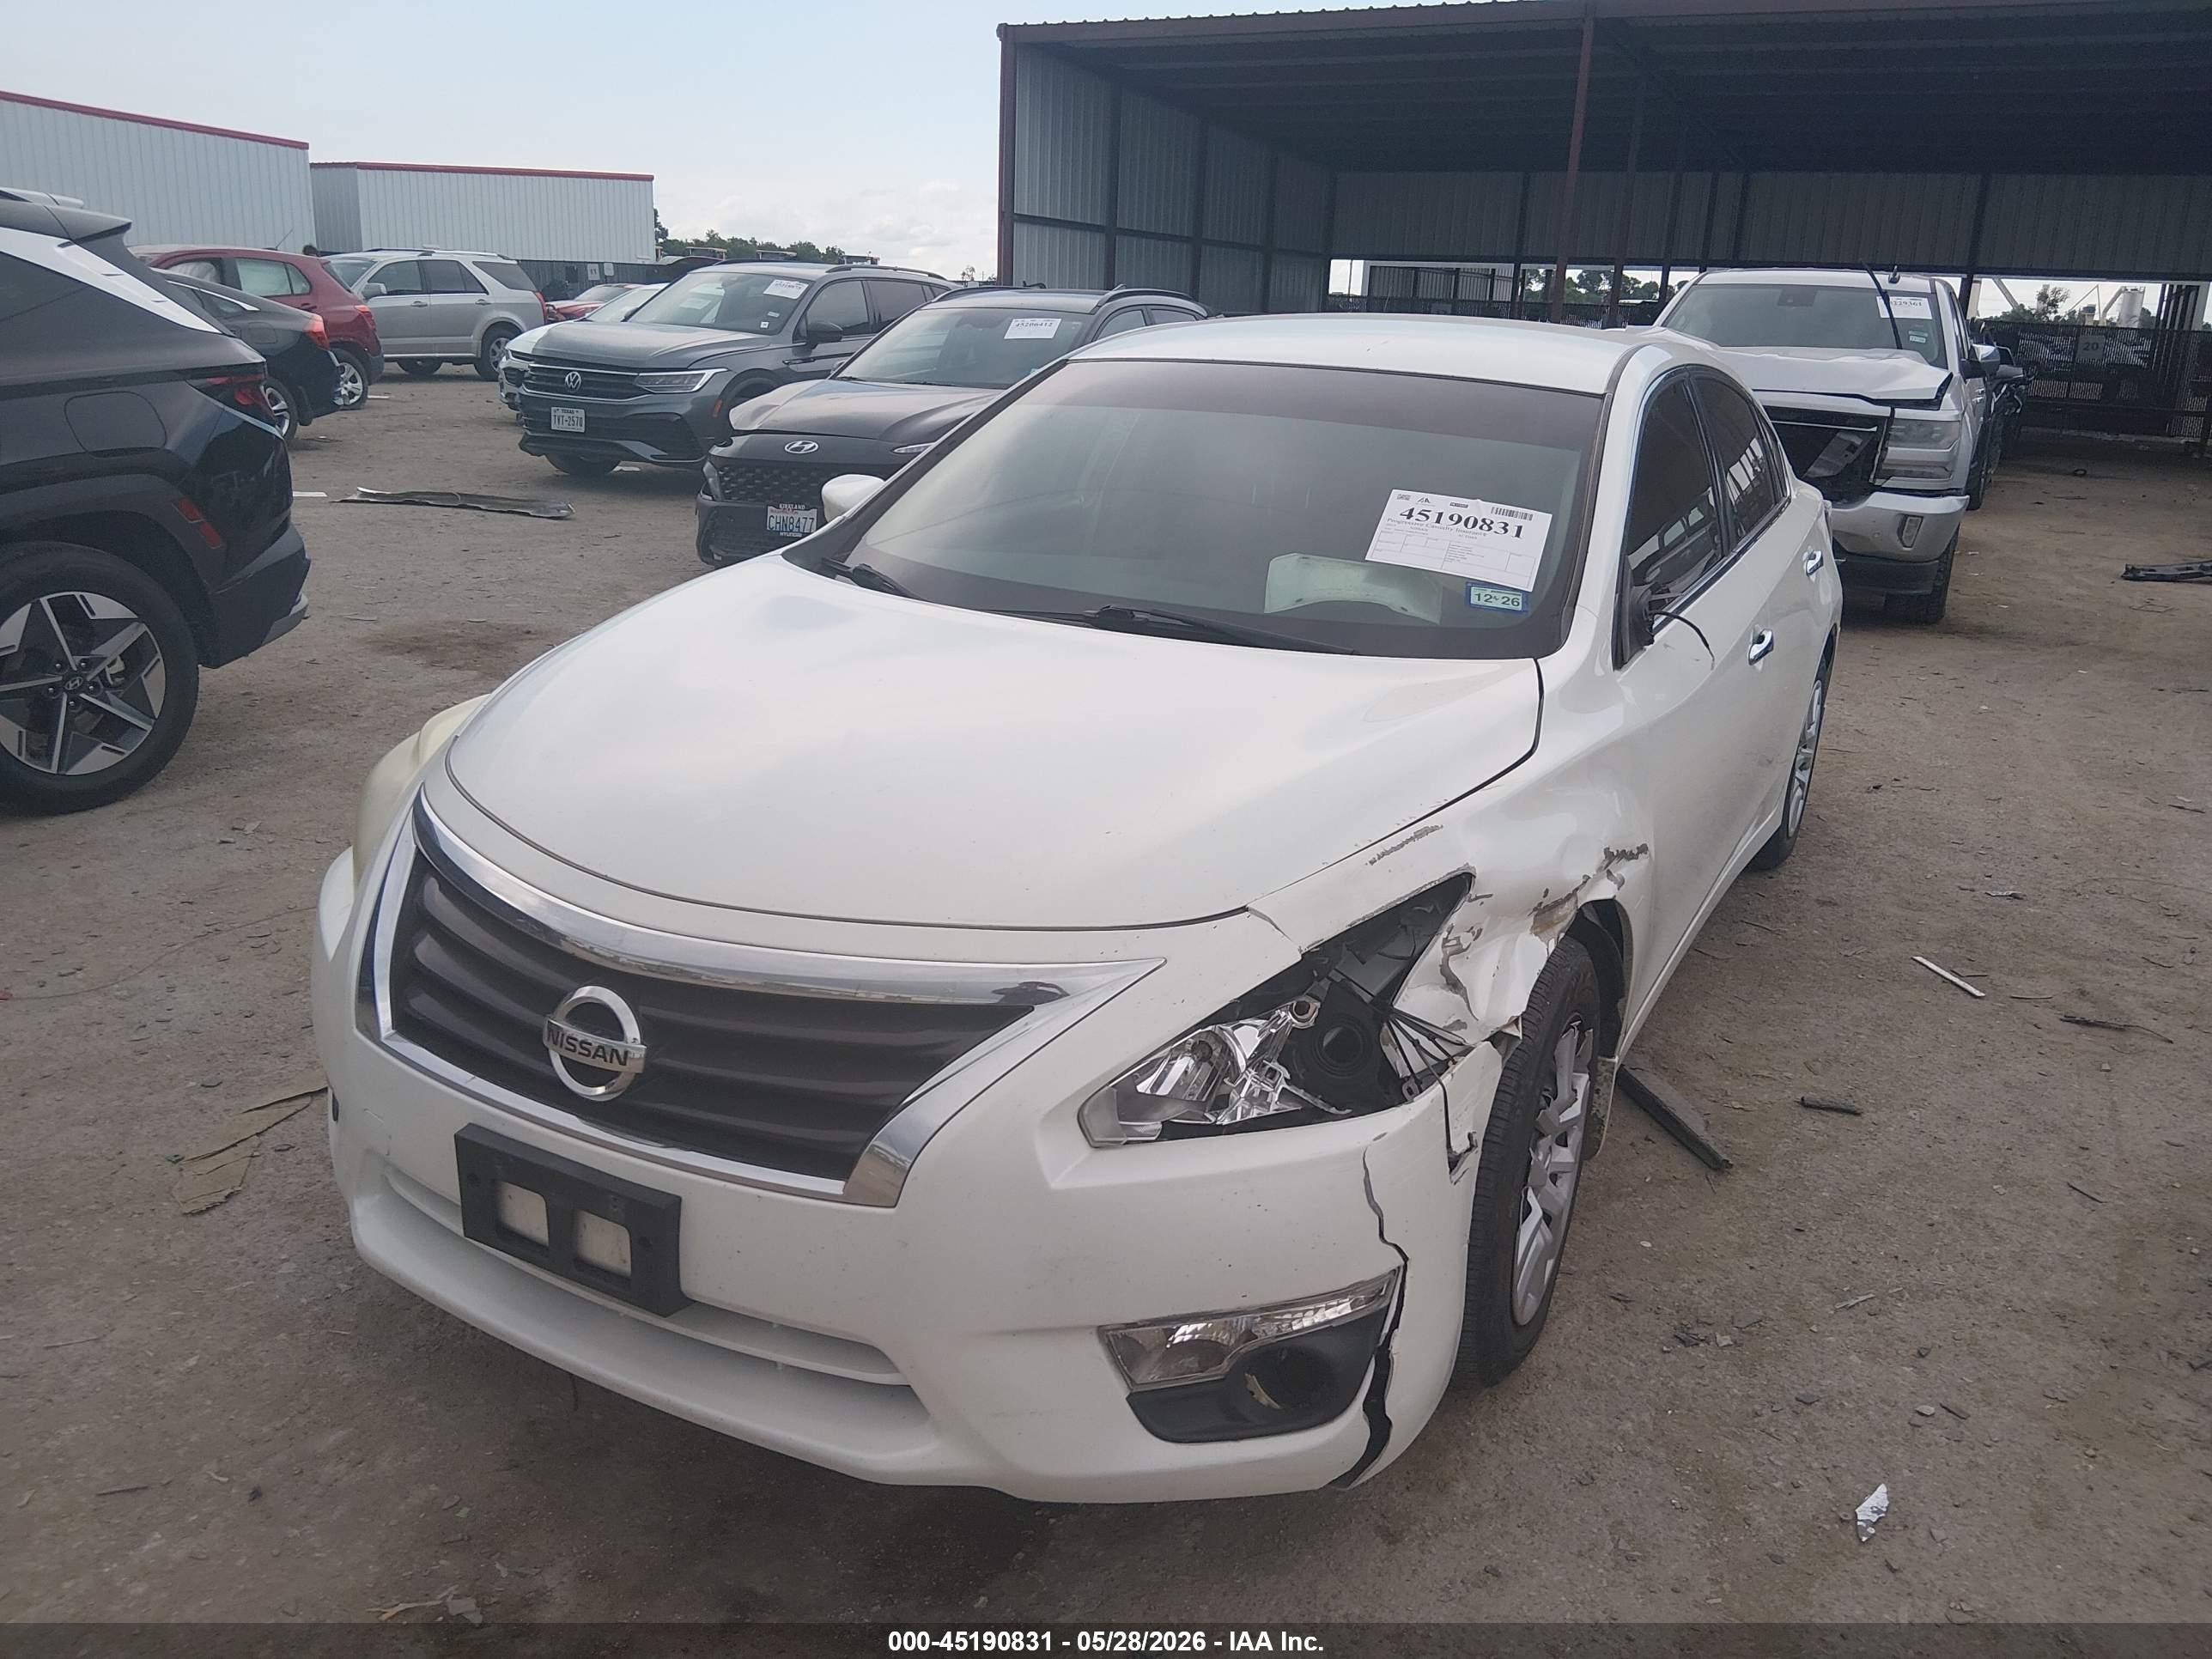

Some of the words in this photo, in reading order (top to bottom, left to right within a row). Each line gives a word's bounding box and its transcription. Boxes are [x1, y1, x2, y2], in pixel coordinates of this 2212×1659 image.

[2082, 342, 2100, 351] 20
[769, 515, 815, 532] CHN8477
[1399, 507, 1524, 539] 45190831
[1474, 592, 1493, 604] 12
[1501, 595, 1521, 607] 26
[547, 1028, 629, 1066] NISSAN
